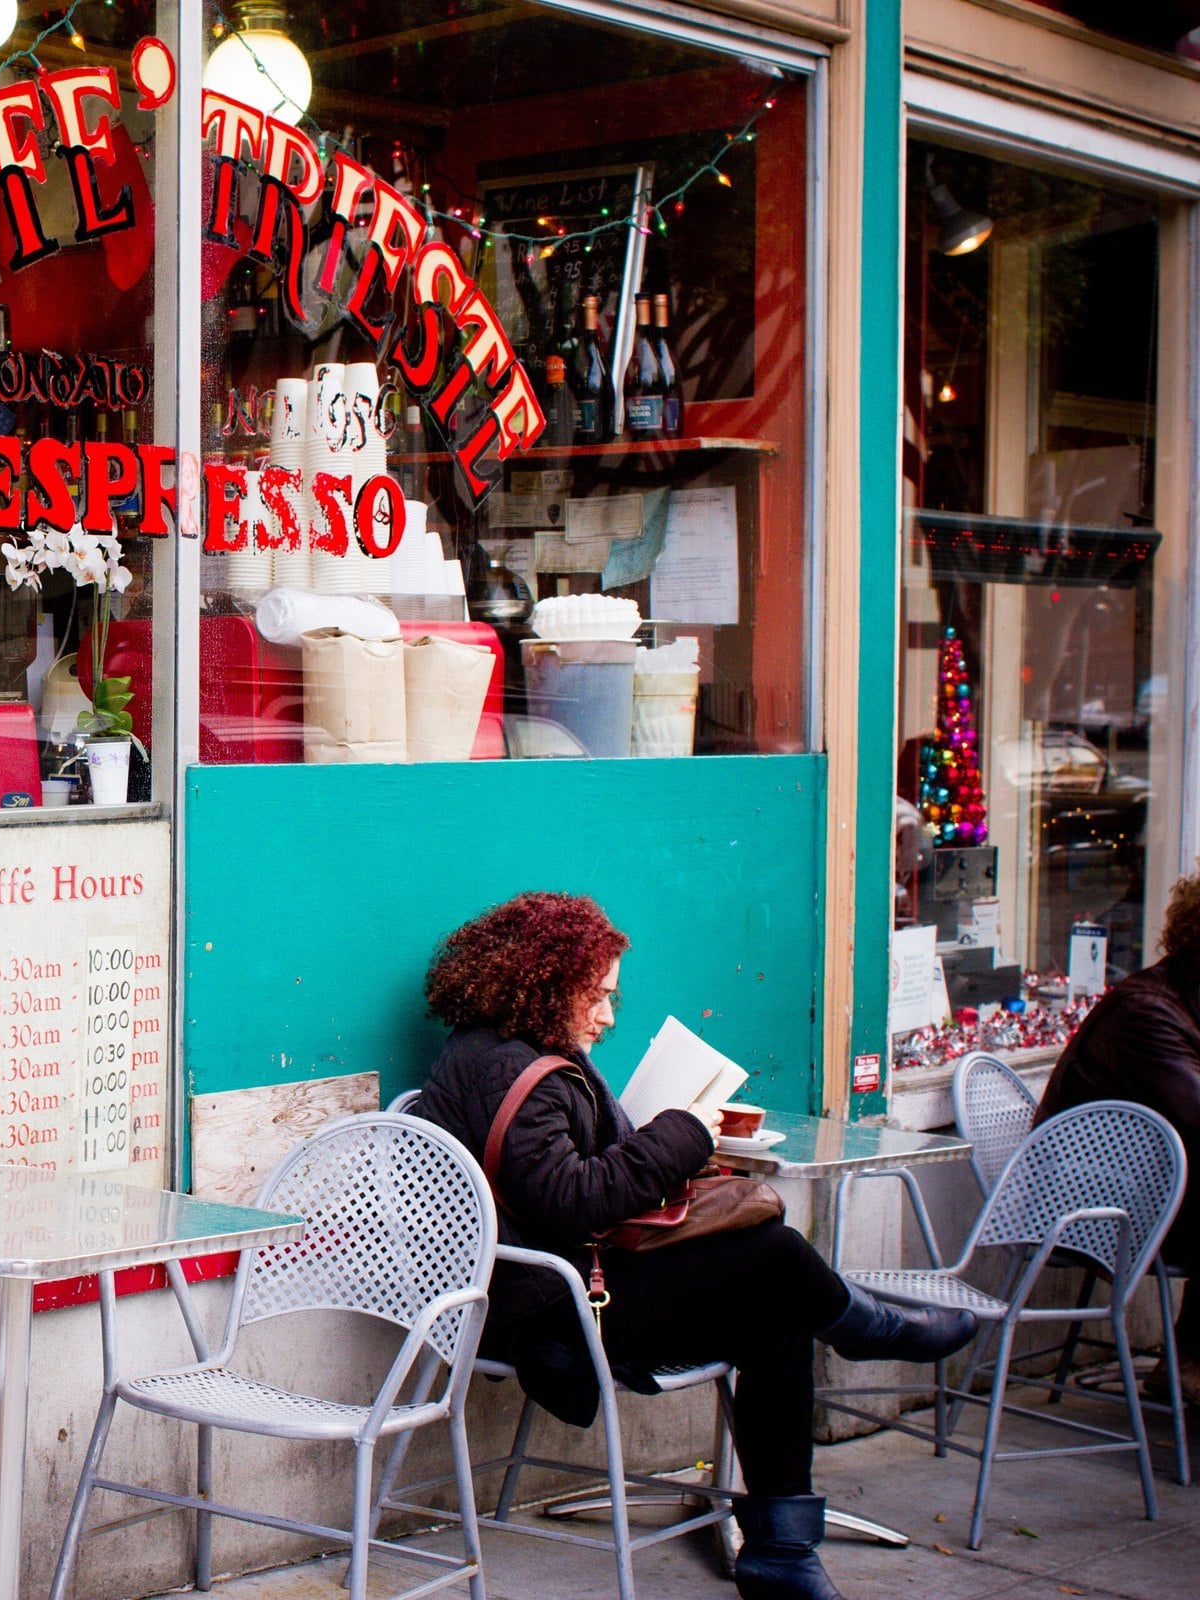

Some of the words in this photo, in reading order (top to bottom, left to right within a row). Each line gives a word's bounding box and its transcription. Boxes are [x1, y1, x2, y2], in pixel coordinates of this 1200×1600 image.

[559, 177, 608, 205] List
[201, 89, 547, 508] TRIESTE
[52, 865, 144, 901] Hours
[88, 949, 134, 974] 10:00
[134, 954, 161, 974] pm
[88, 981, 131, 1006] 10:00
[133, 986, 161, 1006] pm
[132, 1018, 160, 1040] pm
[131, 1050, 159, 1071] pm
[85, 1070, 127, 1097] 10:00
[129, 1081, 158, 1104] pm
